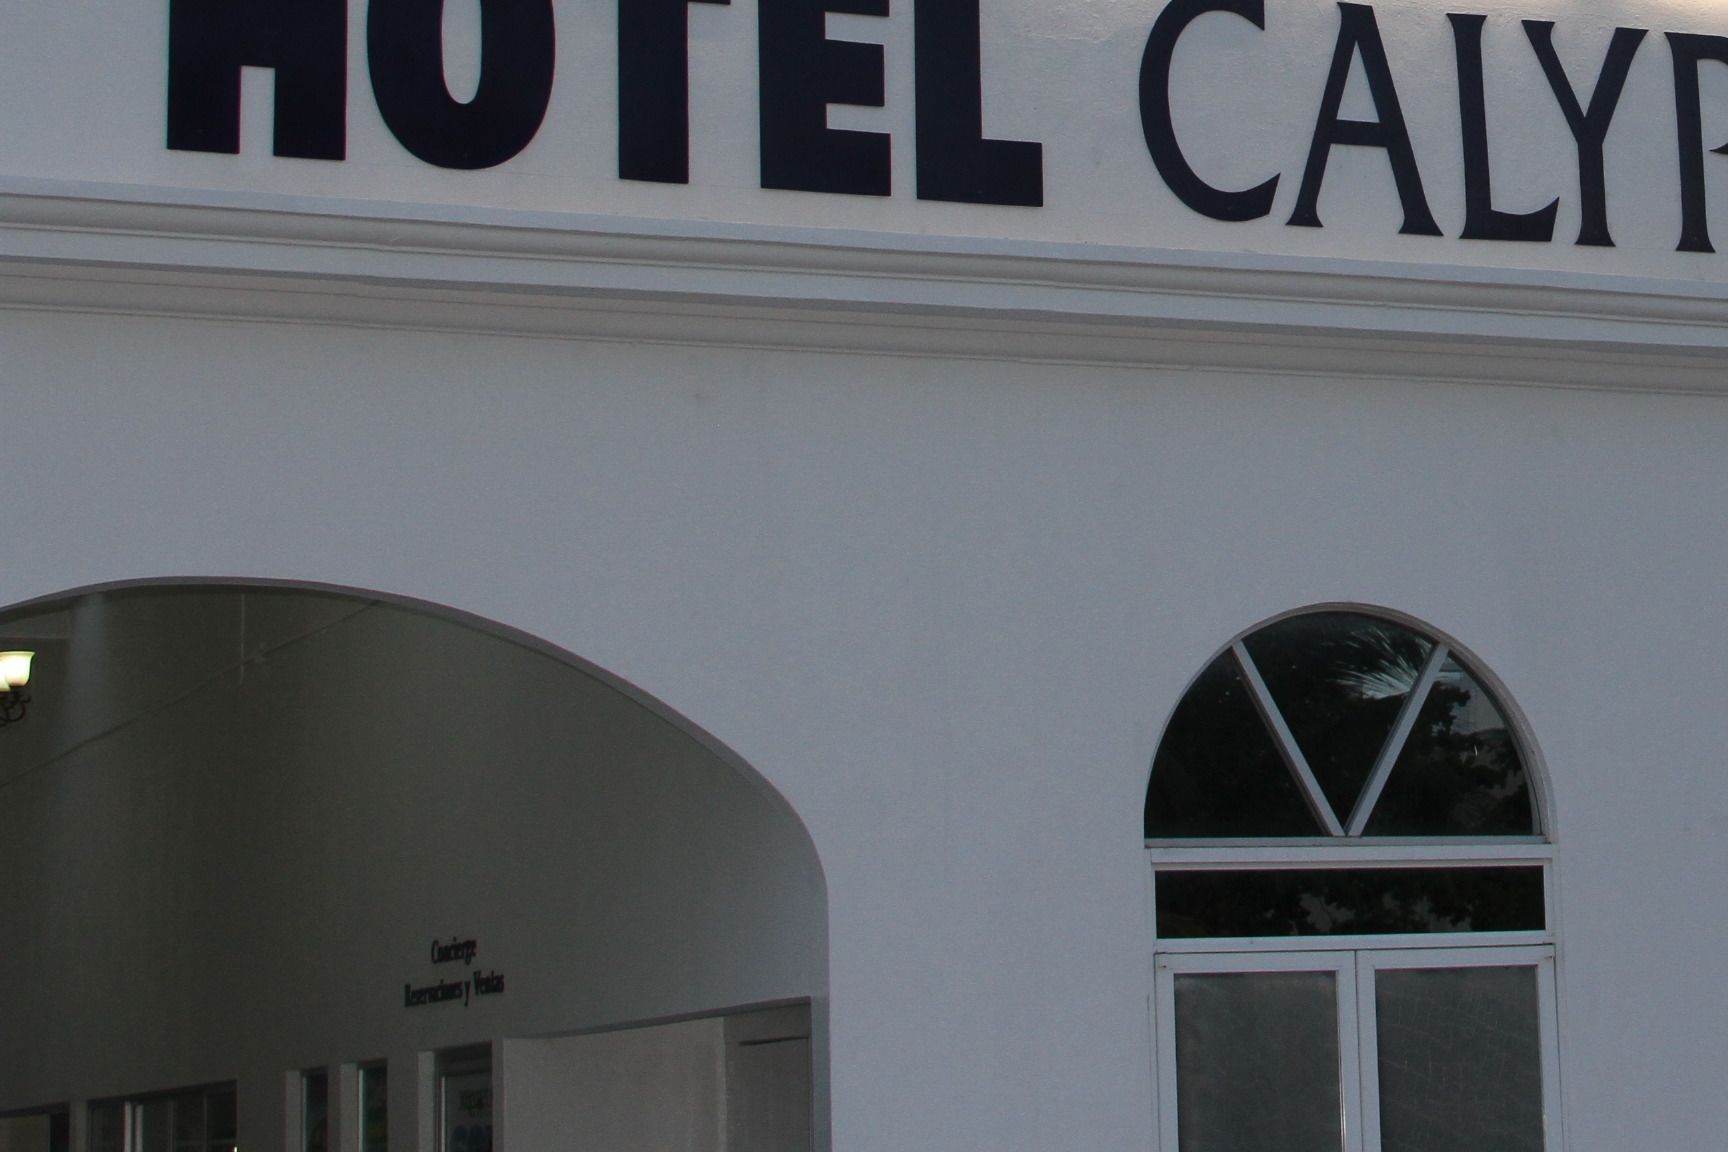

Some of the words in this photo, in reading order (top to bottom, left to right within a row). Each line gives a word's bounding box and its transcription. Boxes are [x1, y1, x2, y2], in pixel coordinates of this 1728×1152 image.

[431, 936, 477, 965] Concierge
[464, 980, 471, 1007] y
[473, 970, 504, 996] Ventas
